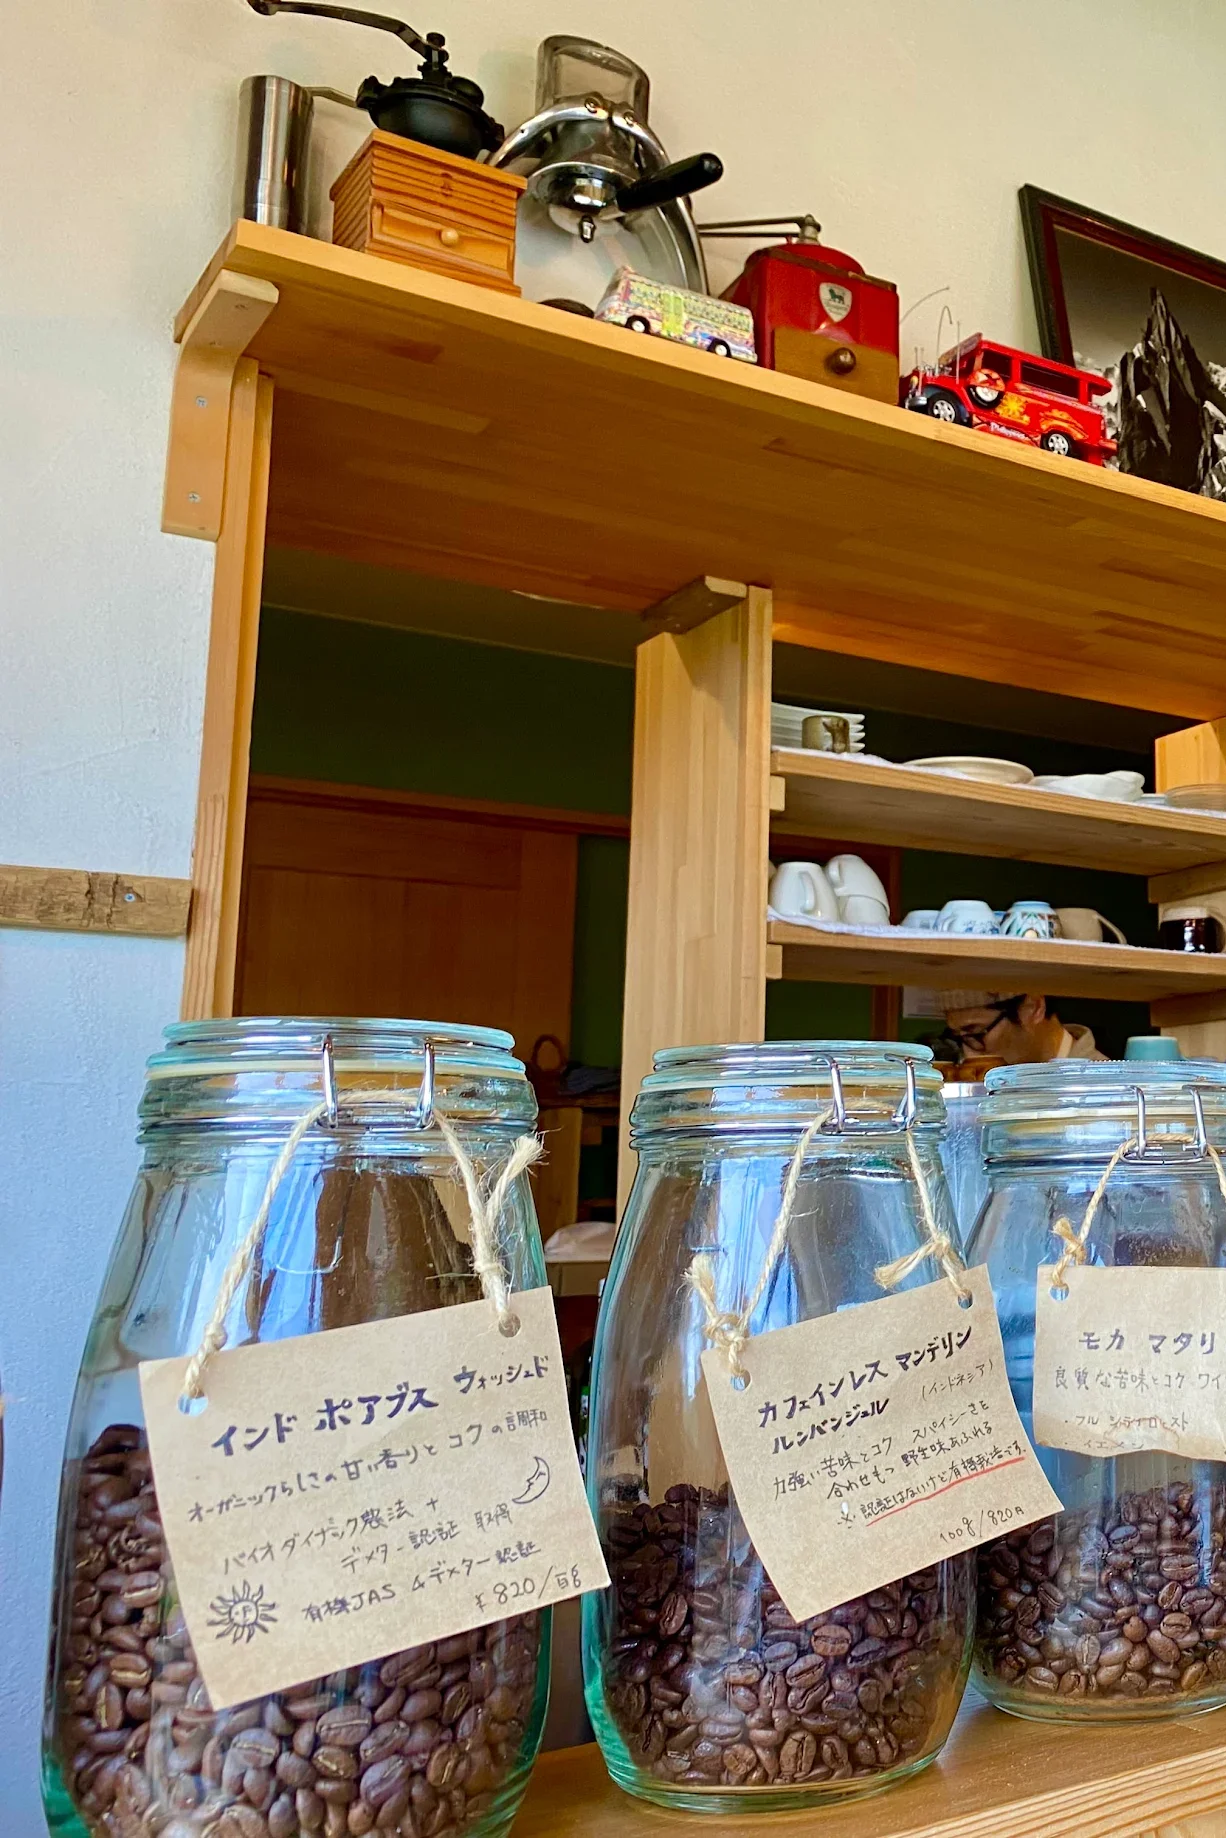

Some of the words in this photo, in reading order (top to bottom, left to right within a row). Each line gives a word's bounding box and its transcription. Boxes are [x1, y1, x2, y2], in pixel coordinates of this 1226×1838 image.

[758, 1359, 889, 1428] カフェインレス
[895, 1326, 972, 1371] マンデリン
[1079, 1329, 1125, 1352] モカ
[1148, 1332, 1217, 1355] マタリ
[210, 1412, 298, 1457] インド
[314, 1384, 440, 1432] ポアブス
